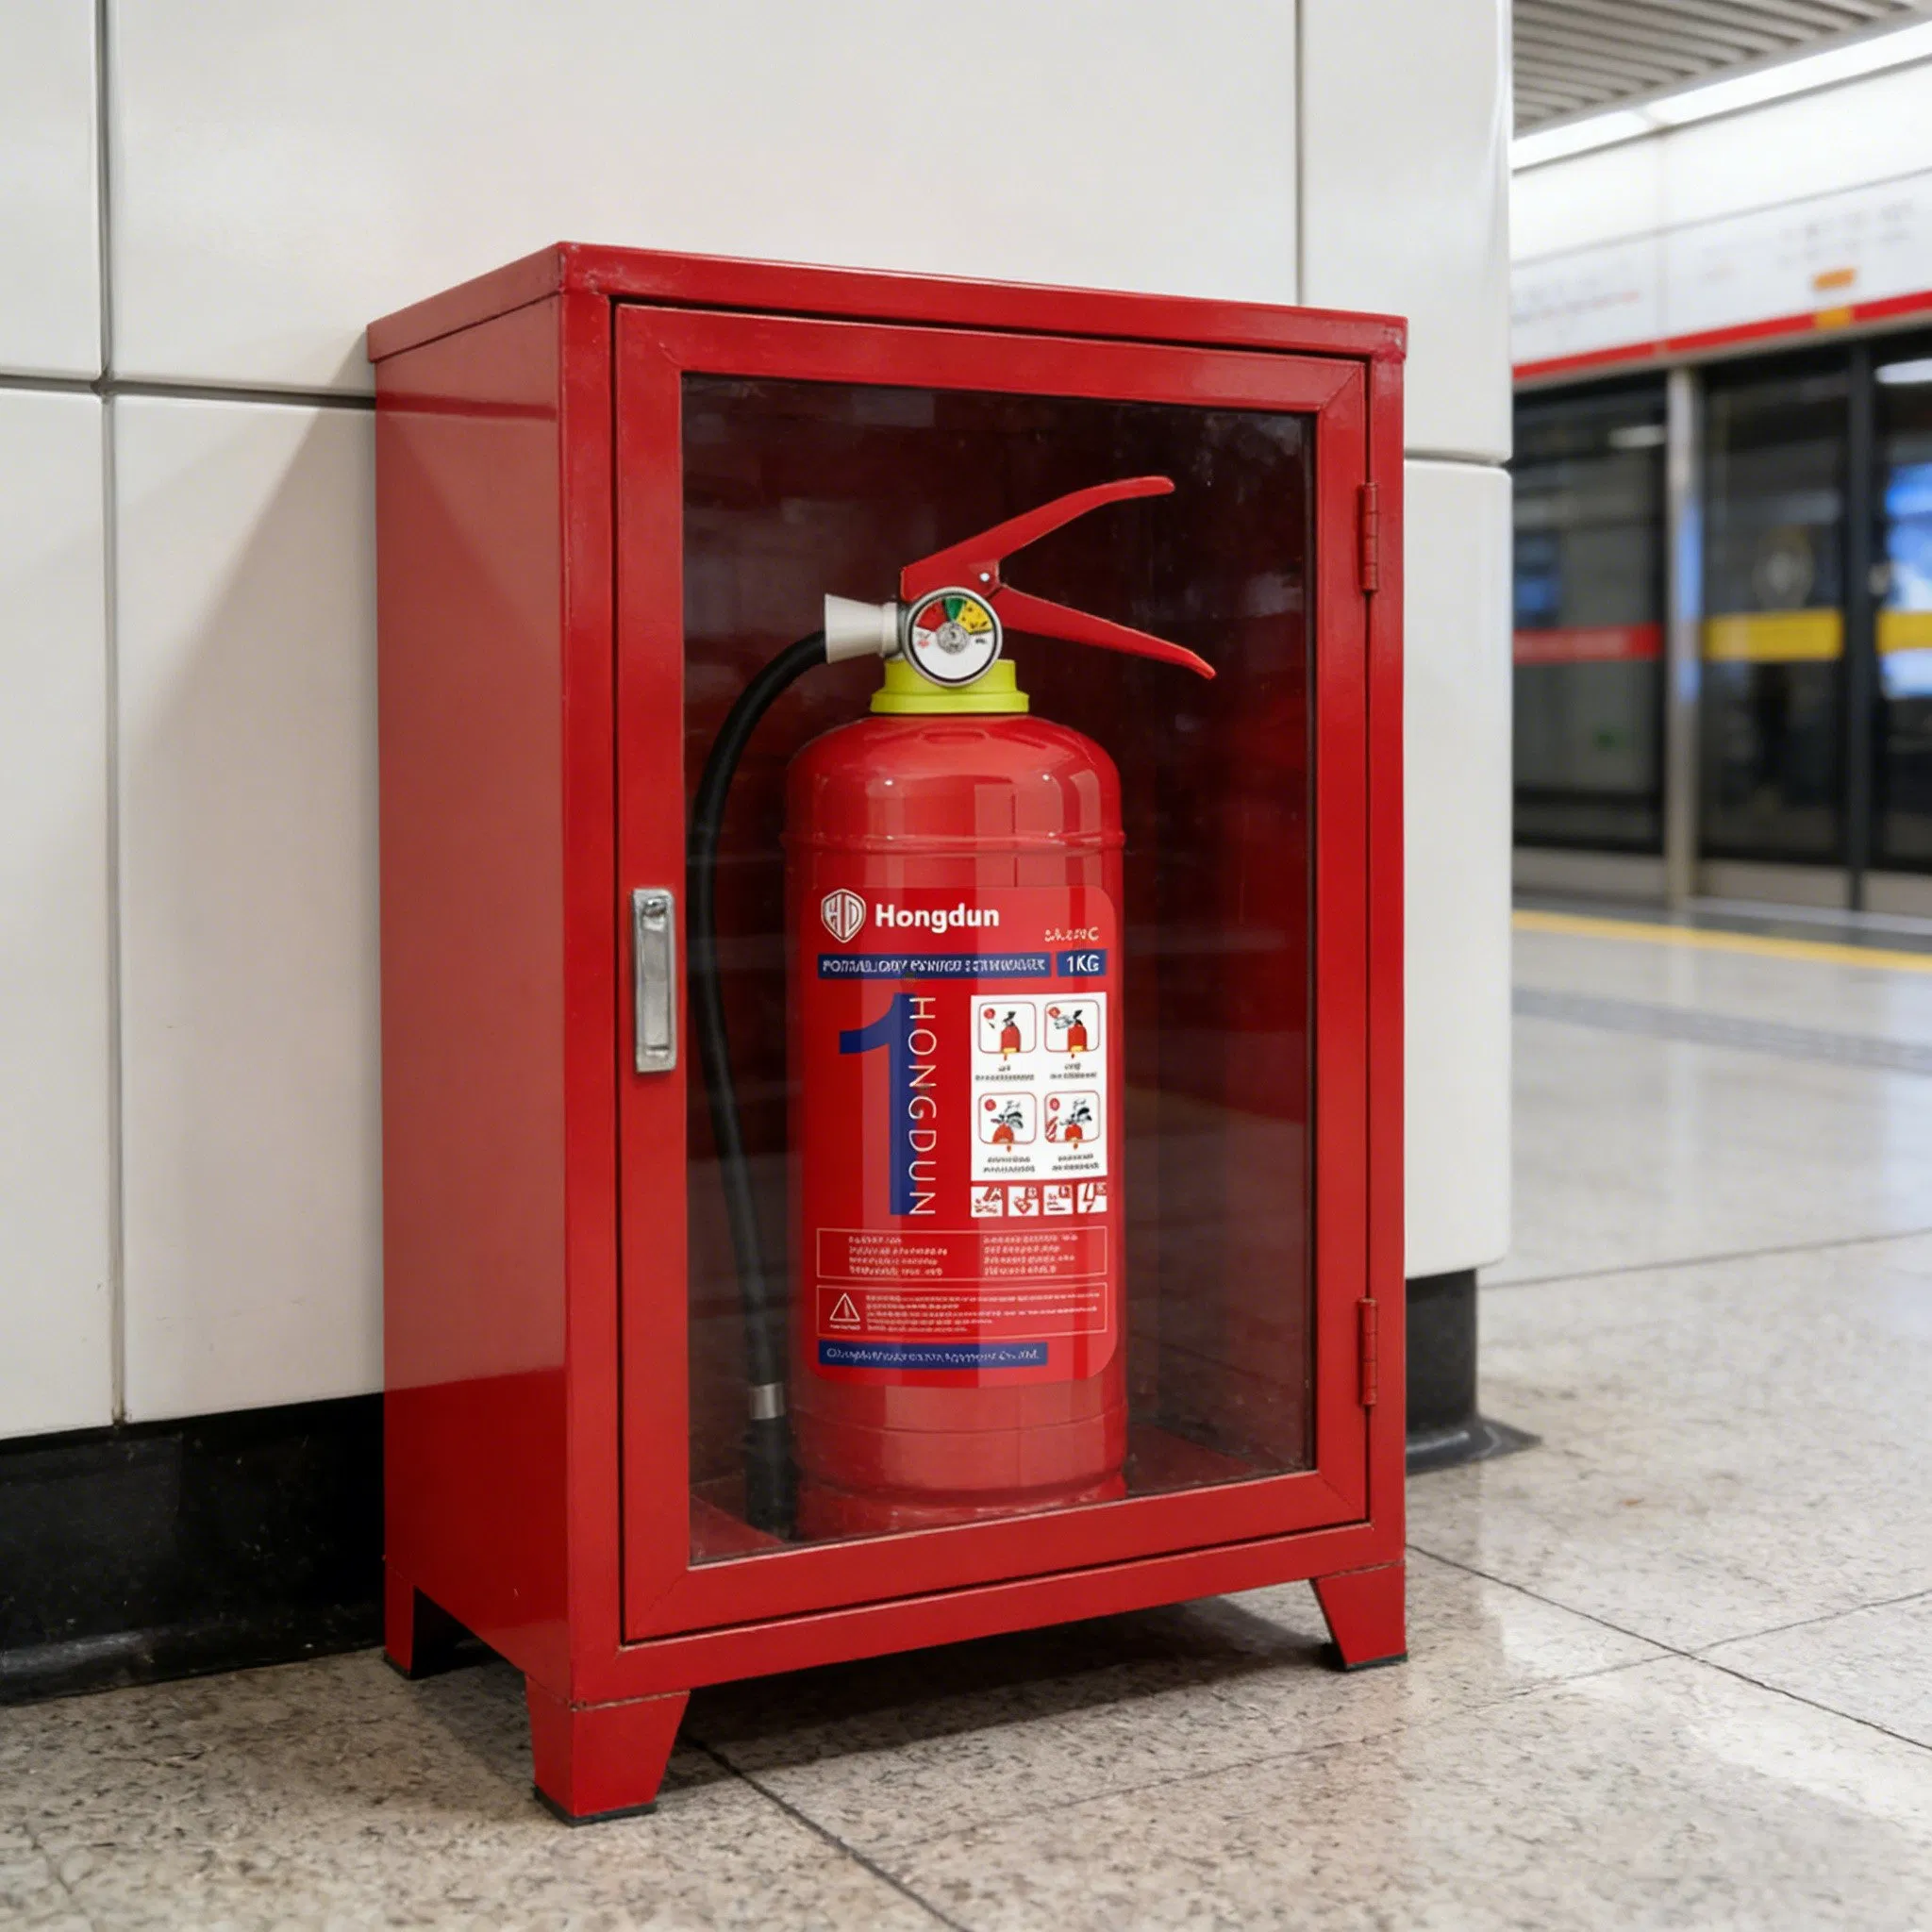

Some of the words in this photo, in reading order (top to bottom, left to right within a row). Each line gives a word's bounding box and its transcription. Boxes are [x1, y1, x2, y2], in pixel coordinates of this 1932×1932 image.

[875, 903, 999, 933] Hongdun
[1066, 955, 1100, 973] 1KG
[908, 997, 937, 1215] HONGDUN
